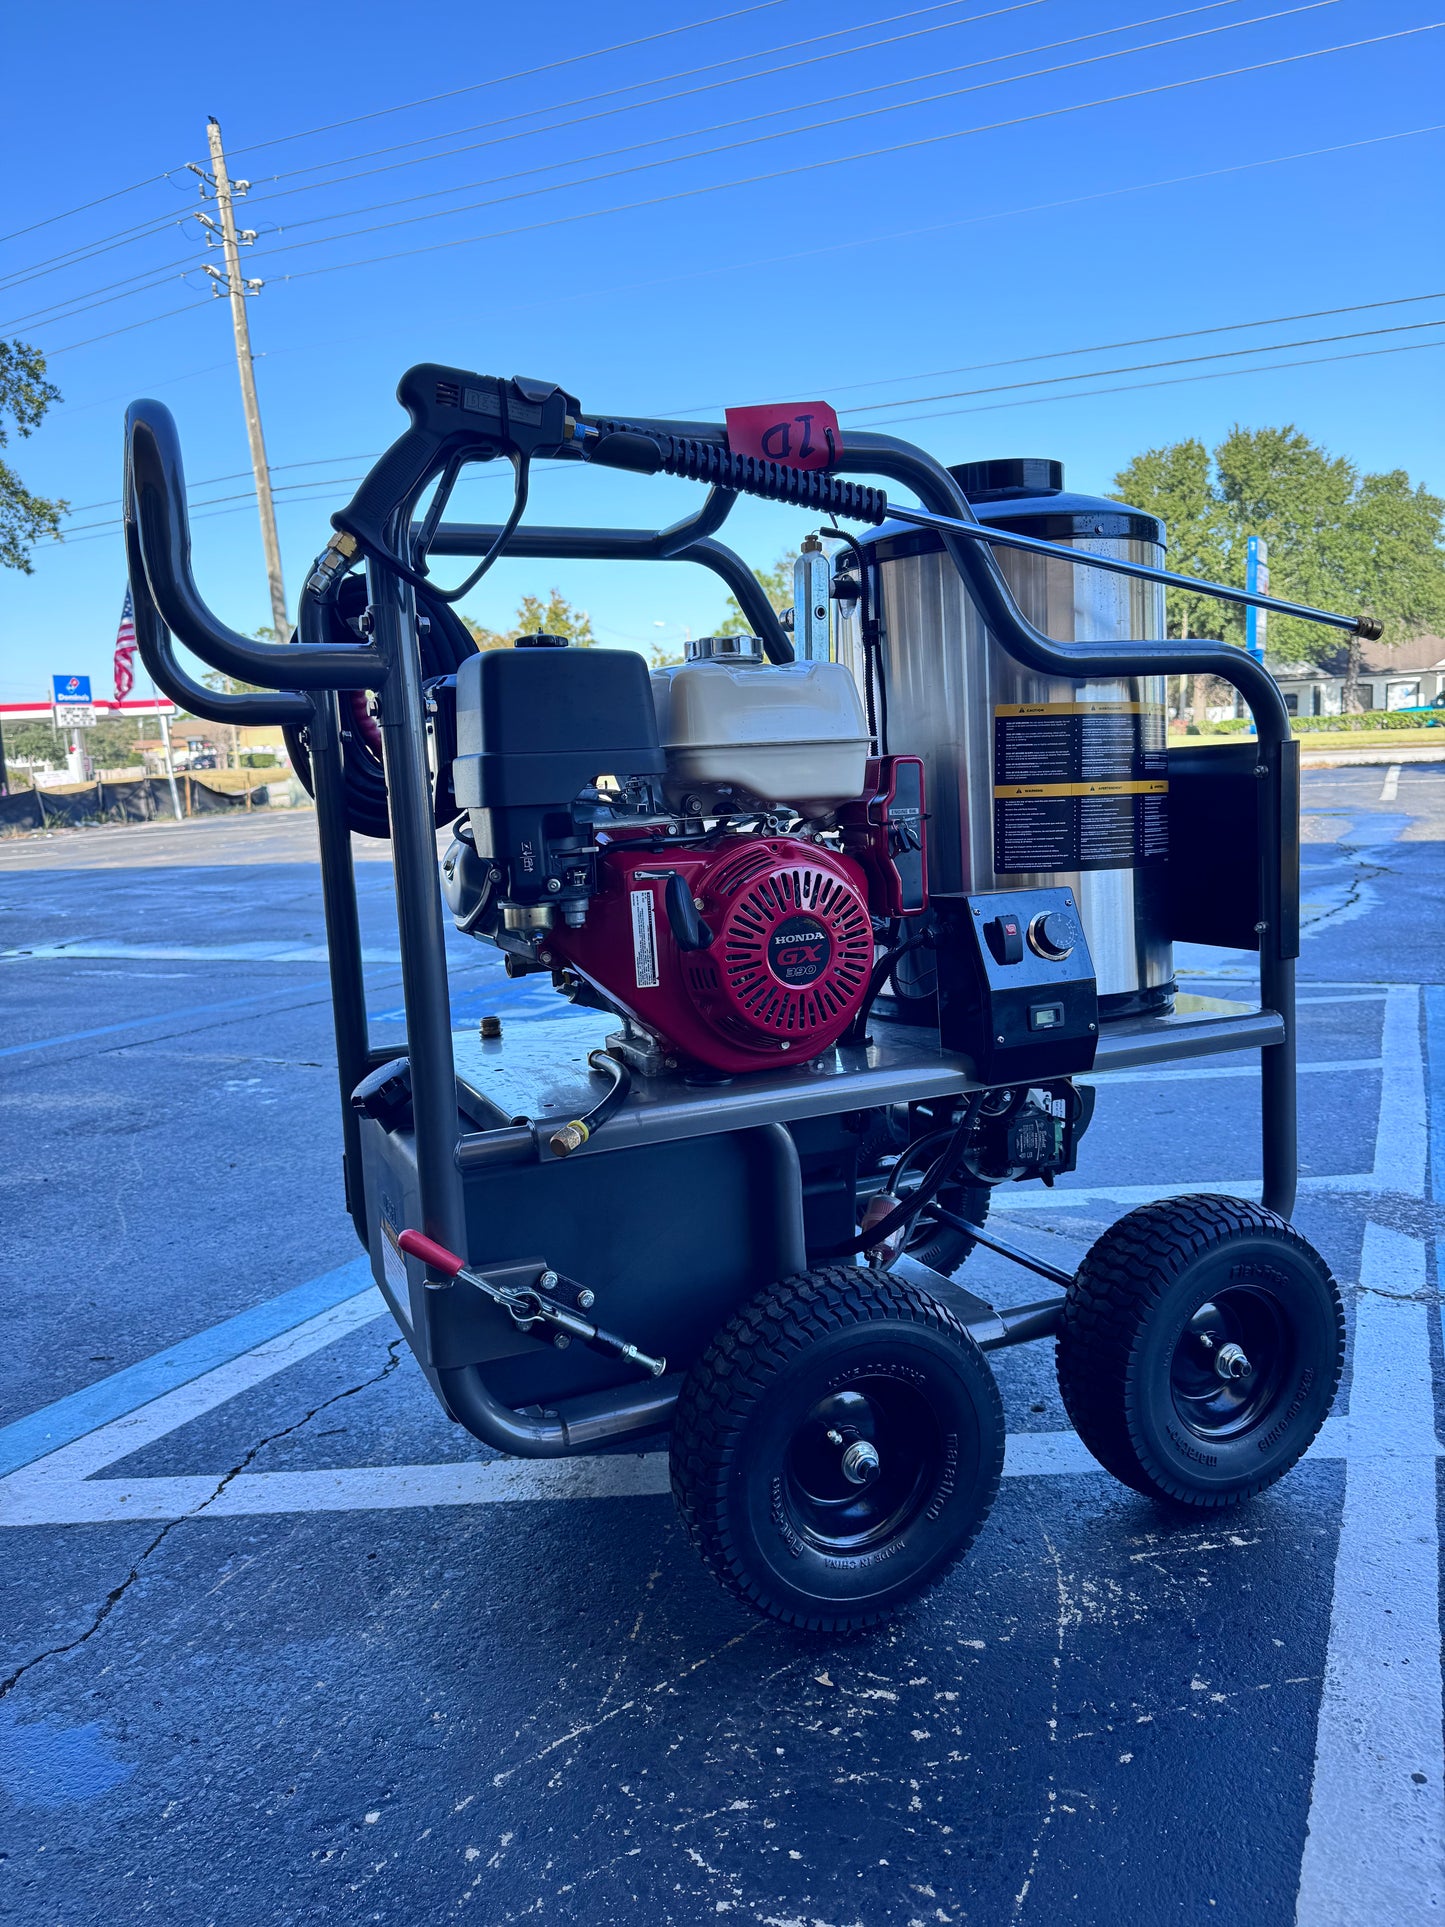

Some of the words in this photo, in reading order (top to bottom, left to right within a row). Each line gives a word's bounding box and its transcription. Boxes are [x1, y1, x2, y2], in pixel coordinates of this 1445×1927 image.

[775, 931, 825, 945] HONDA
[776, 944, 823, 966] GX
[785, 964, 817, 978] 390
[873, 1540, 906, 1564] MADE
[824, 1557, 857, 1570] CHINA
[859, 1557, 872, 1569] IN
